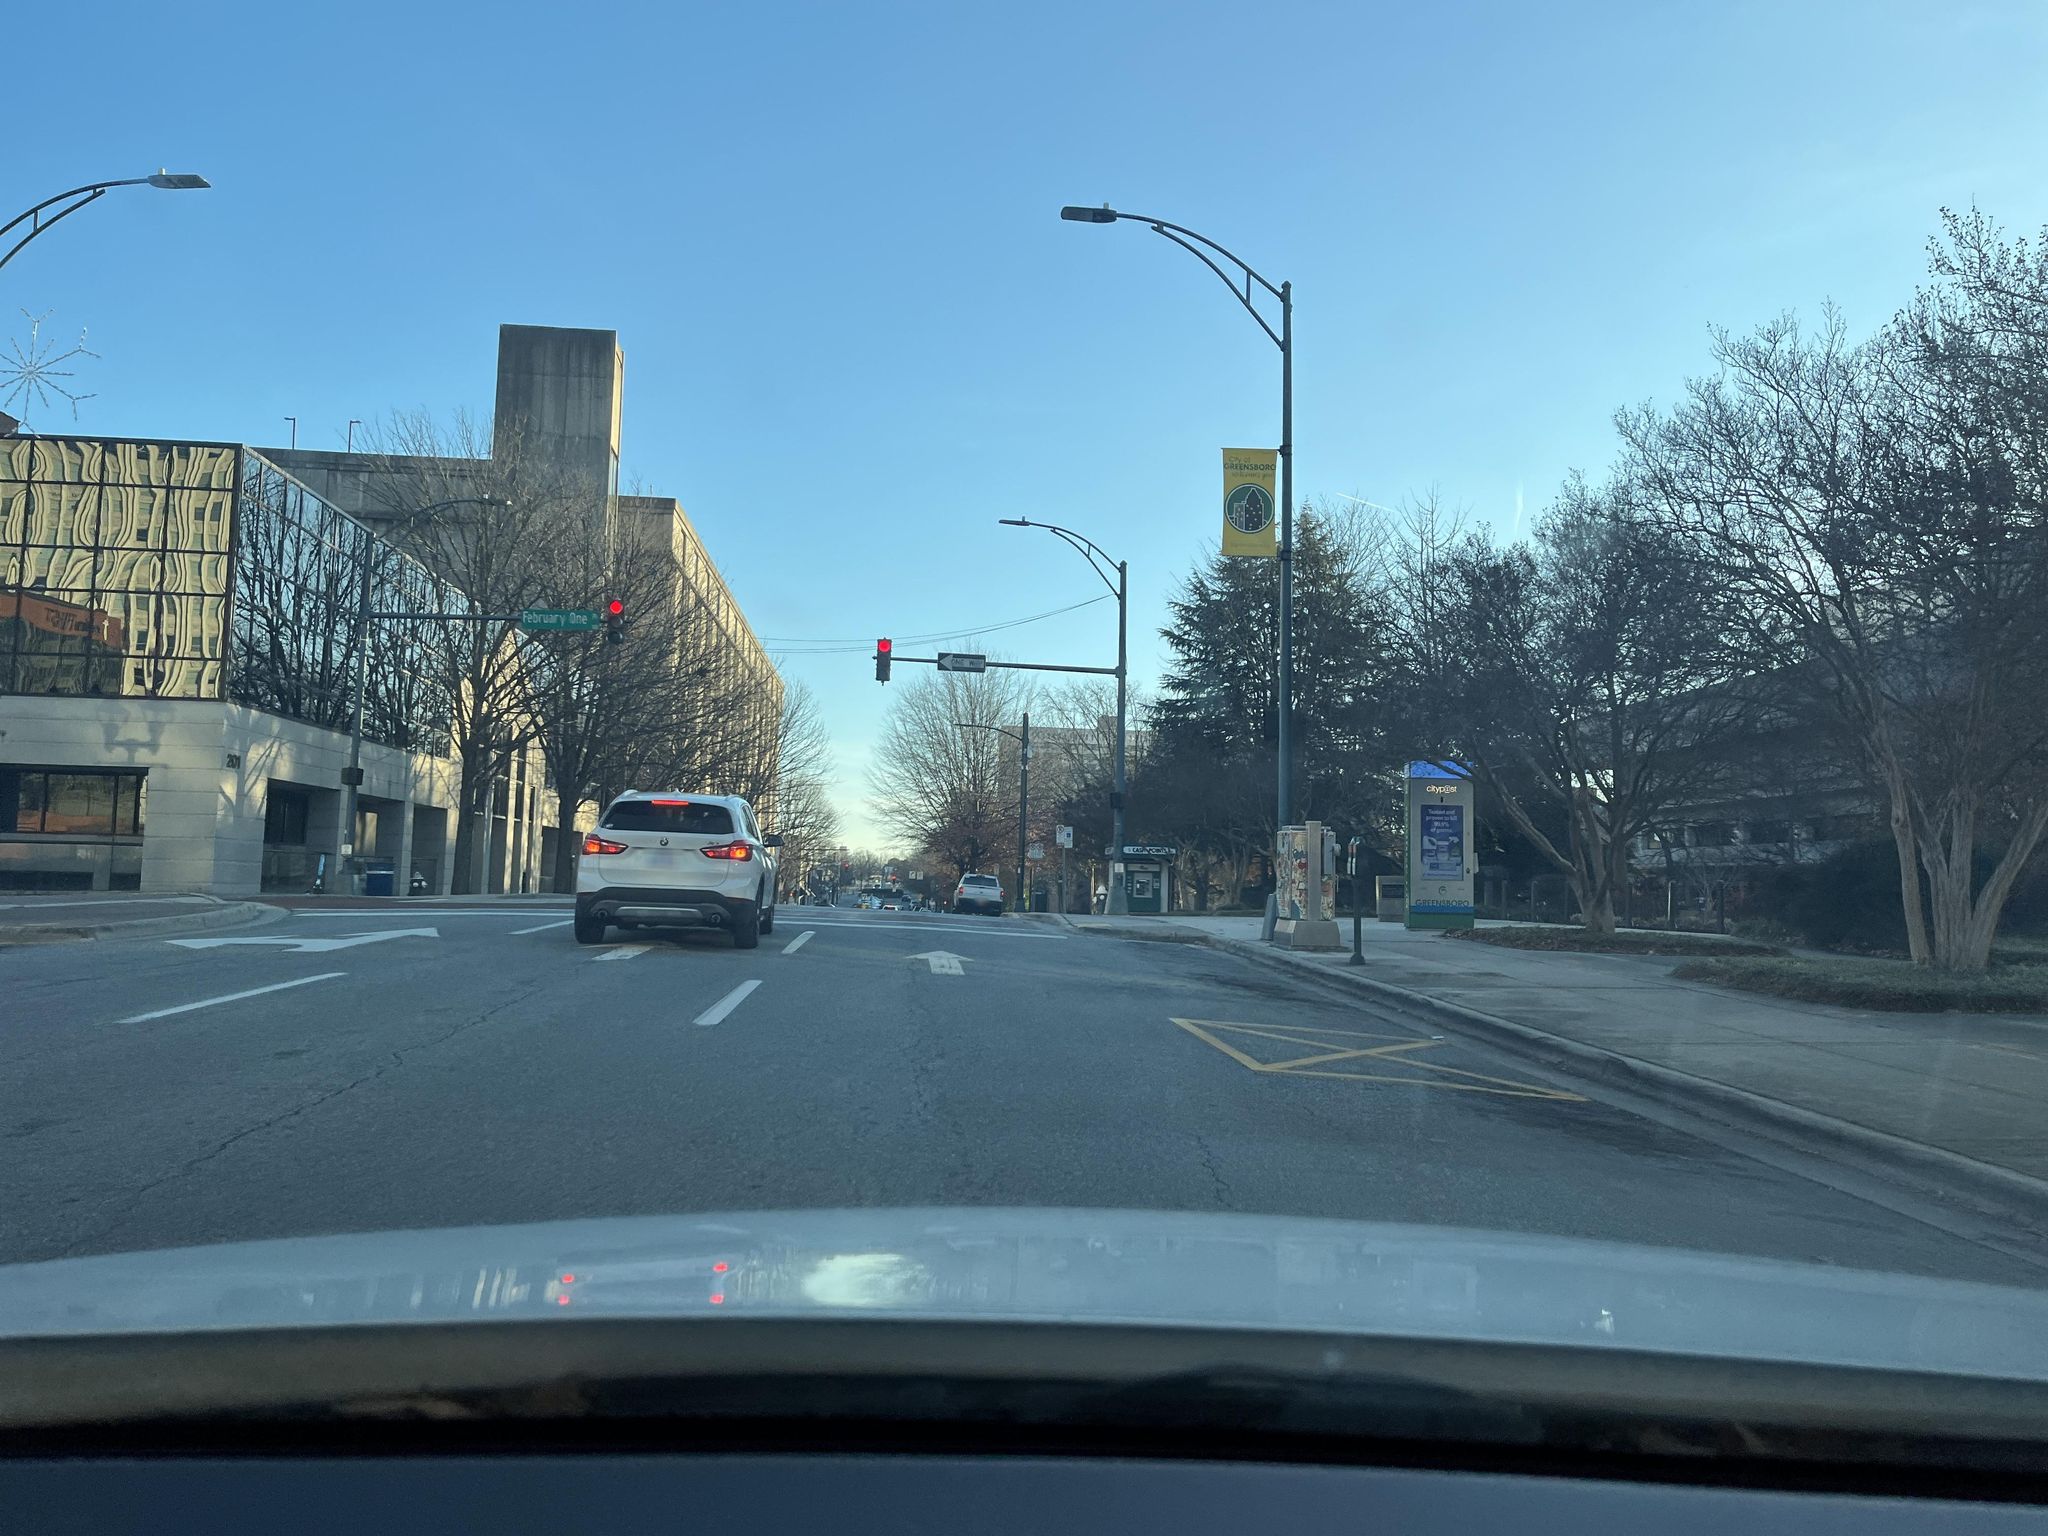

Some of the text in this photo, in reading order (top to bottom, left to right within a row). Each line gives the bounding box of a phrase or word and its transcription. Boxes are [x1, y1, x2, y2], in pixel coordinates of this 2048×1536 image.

[1224, 463, 1276, 471] GREENSBORO
[522, 611, 566, 627] February
[569, 612, 588, 625] One
[226, 753, 241, 769] 201
[1415, 899, 1470, 908] GREENSBORO
